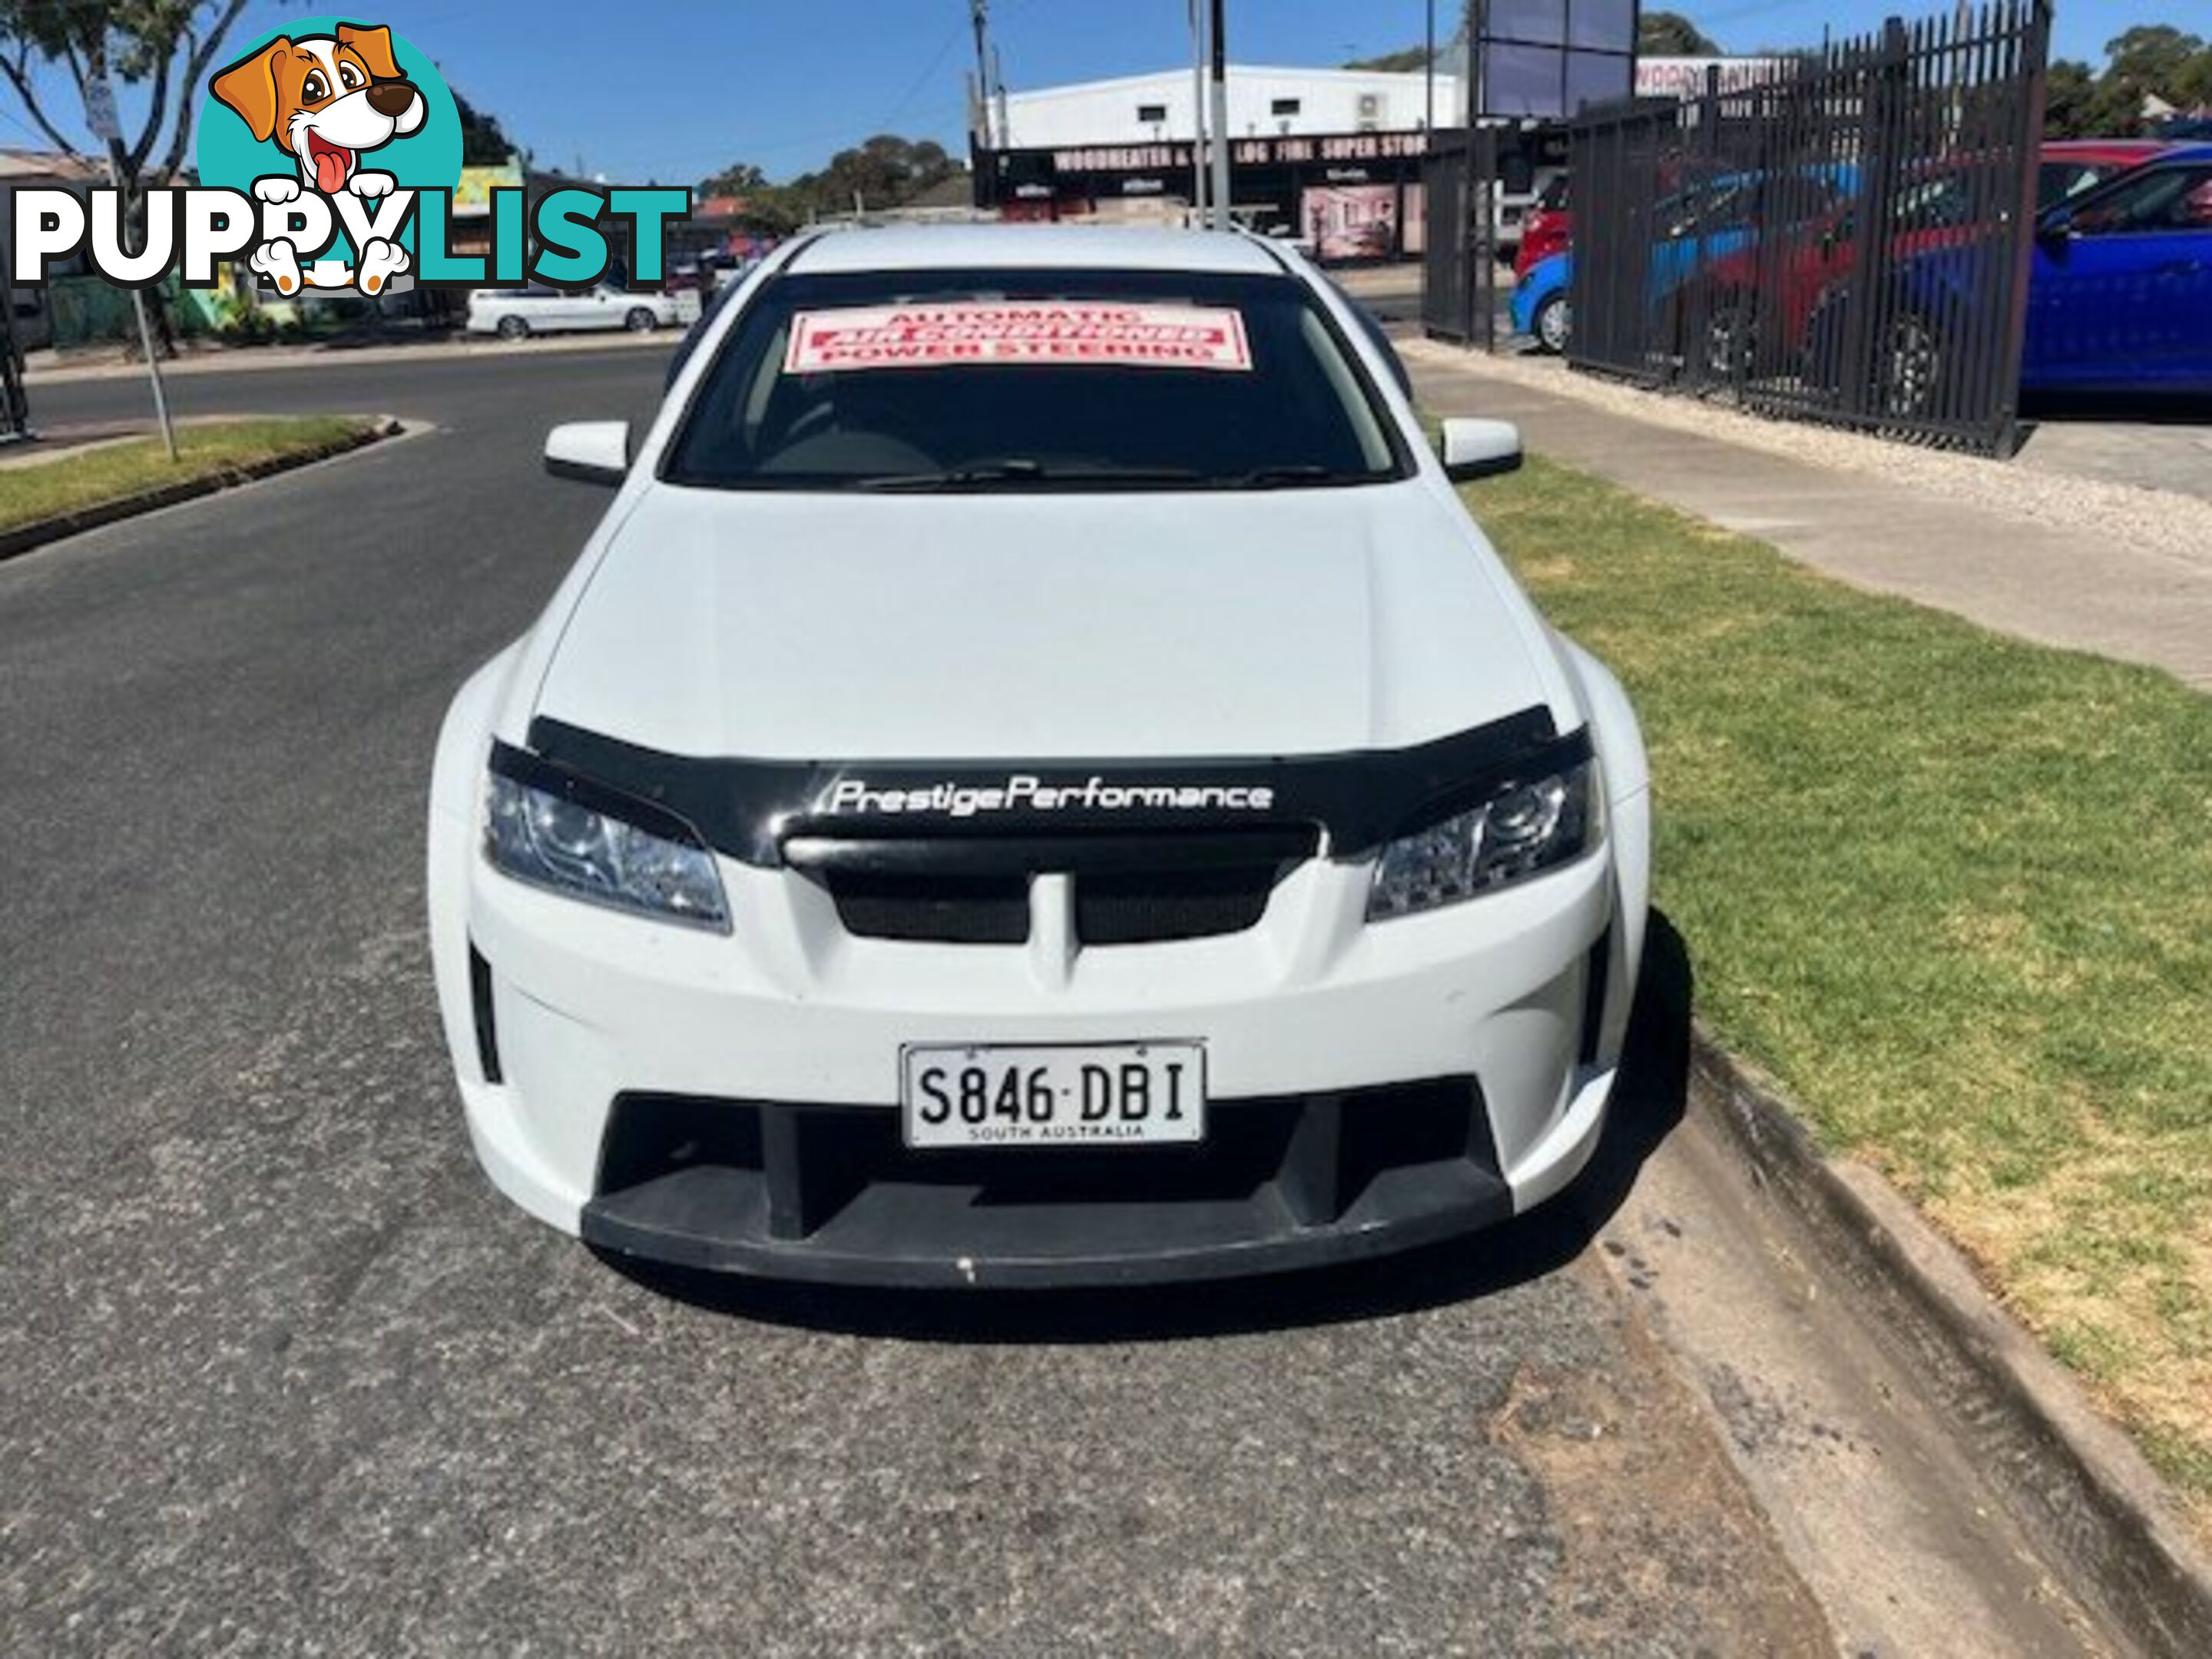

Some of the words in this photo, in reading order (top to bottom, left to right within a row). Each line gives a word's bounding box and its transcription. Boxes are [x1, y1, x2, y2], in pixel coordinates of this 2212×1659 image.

[888, 309, 1141, 325] AUTOMATIC
[820, 343, 982, 361] POWER
[995, 343, 1215, 359] STEERING
[969, 1127, 1031, 1141] SOUTH
[1040, 1125, 1144, 1138] AUSTRALIA
